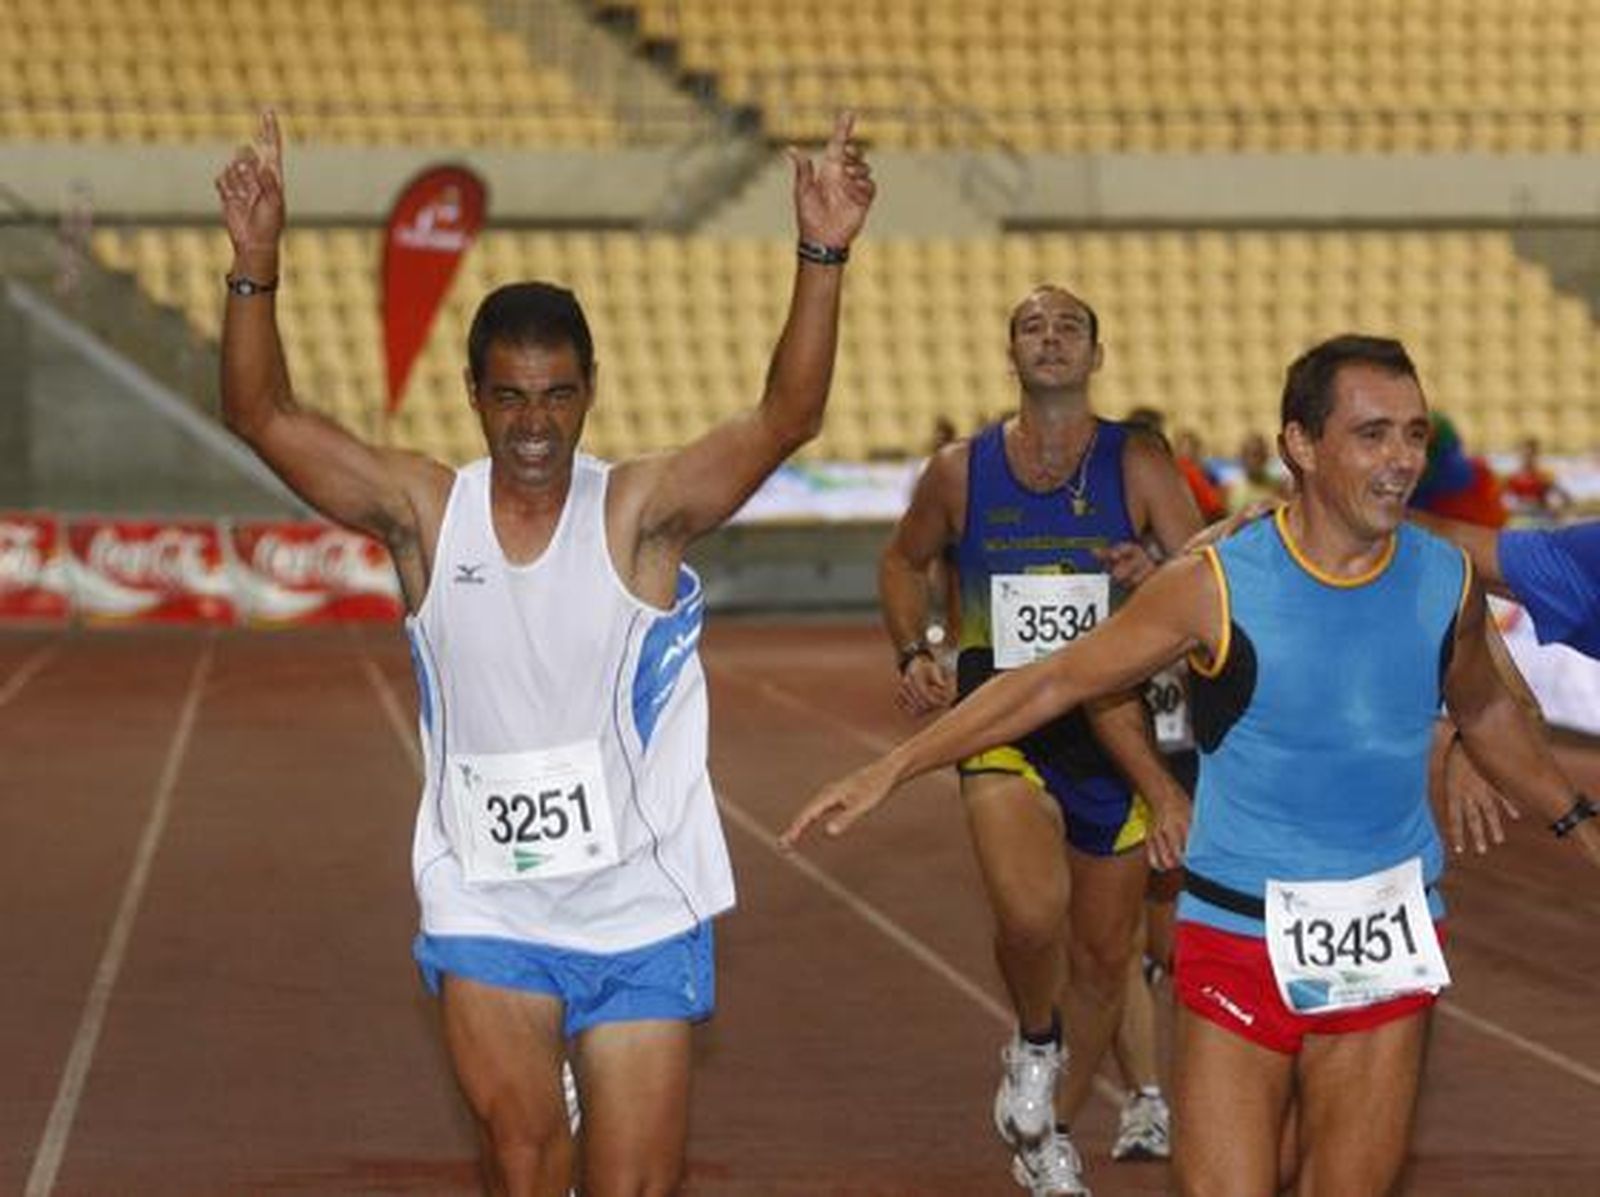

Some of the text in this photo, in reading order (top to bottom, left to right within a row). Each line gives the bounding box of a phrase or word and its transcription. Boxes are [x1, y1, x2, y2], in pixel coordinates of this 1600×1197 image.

[1017, 604, 1097, 642] 3534
[486, 784, 592, 844] 3251
[1284, 904, 1417, 967] 13451
